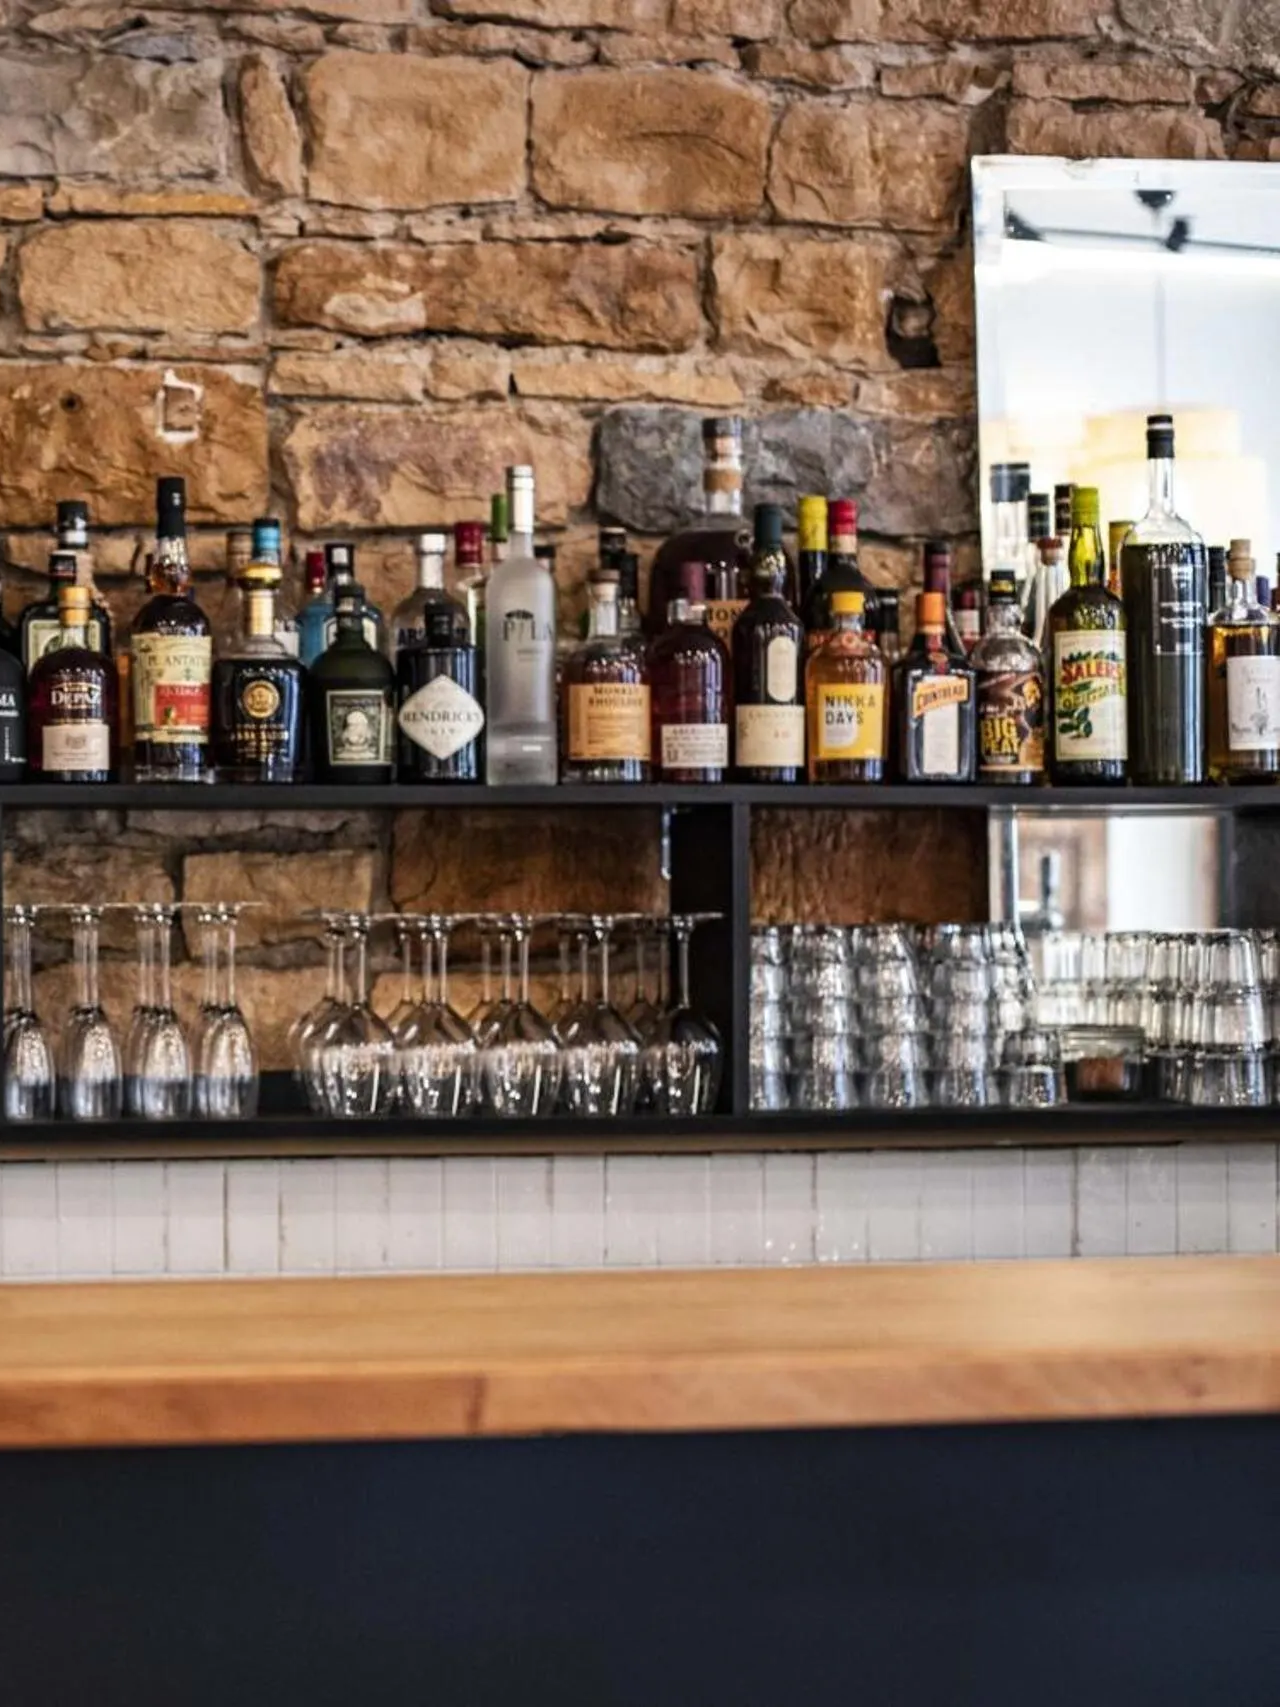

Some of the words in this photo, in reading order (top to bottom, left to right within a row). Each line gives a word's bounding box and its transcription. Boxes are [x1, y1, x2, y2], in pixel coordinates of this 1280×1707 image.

[824, 694, 876, 708] NIKKA
[824, 711, 864, 726] DAYS
[981, 717, 1017, 738] BIG
